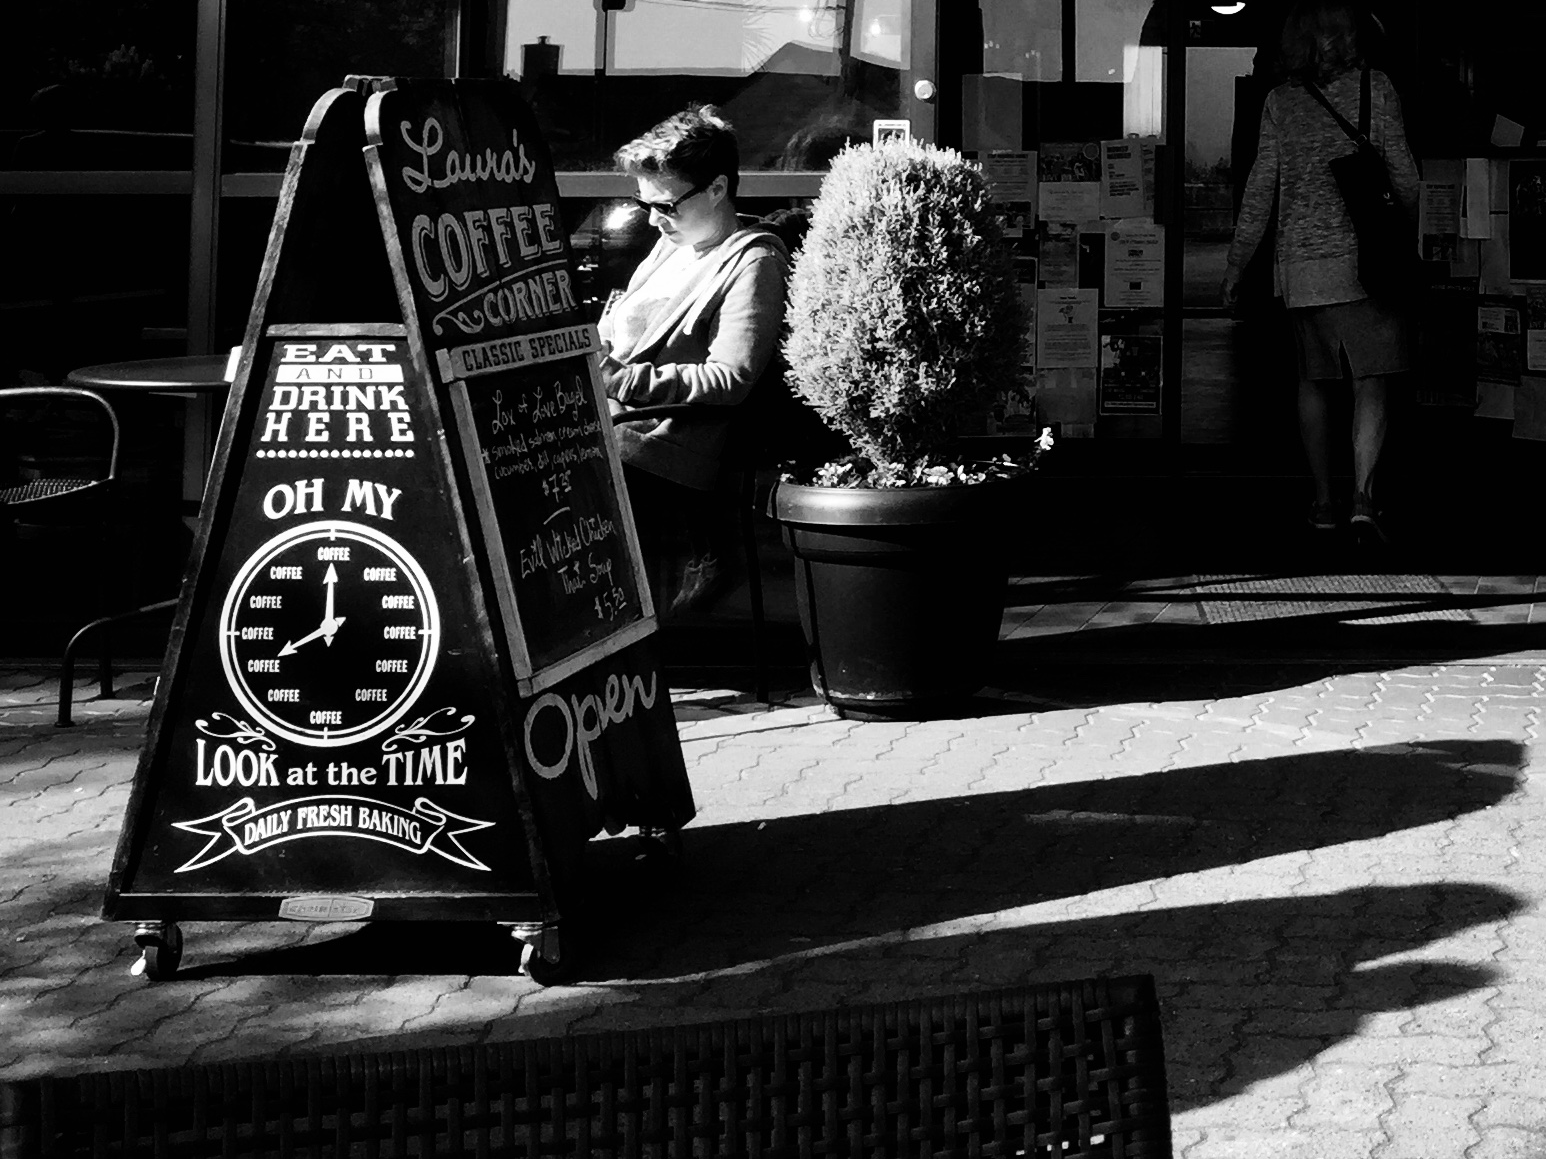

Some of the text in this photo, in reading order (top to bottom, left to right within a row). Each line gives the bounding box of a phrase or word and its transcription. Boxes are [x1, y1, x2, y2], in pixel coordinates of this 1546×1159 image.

[401, 117, 535, 193] Laura's
[412, 204, 563, 302] COFFEE
[483, 269, 578, 327] CORNER
[281, 344, 396, 362] EAT
[462, 328, 592, 371] CLASSIC SPECIALS
[296, 368, 373, 380] AND
[268, 385, 410, 411] DRINK
[533, 386, 557, 423] Love
[260, 412, 415, 442] HERE
[263, 478, 402, 521] OH MY
[318, 547, 350, 561] COFFEE
[270, 566, 302, 580] COFFEE
[364, 568, 397, 581] COFFEE
[250, 596, 282, 609] COFFEE
[382, 596, 414, 609] COFFEE
[242, 627, 274, 640] COFFEE
[384, 626, 416, 640] COFFEE
[248, 660, 280, 673] COFFEE
[376, 660, 408, 673] COFFEE
[268, 689, 300, 702] COFFEE
[355, 689, 387, 702] COFFEE
[310, 711, 342, 725] COFFEE
[524, 671, 656, 800] Open
[195, 737, 468, 786] LOOK at the TIME
[244, 805, 421, 845] DAILY FRESH BAKING
